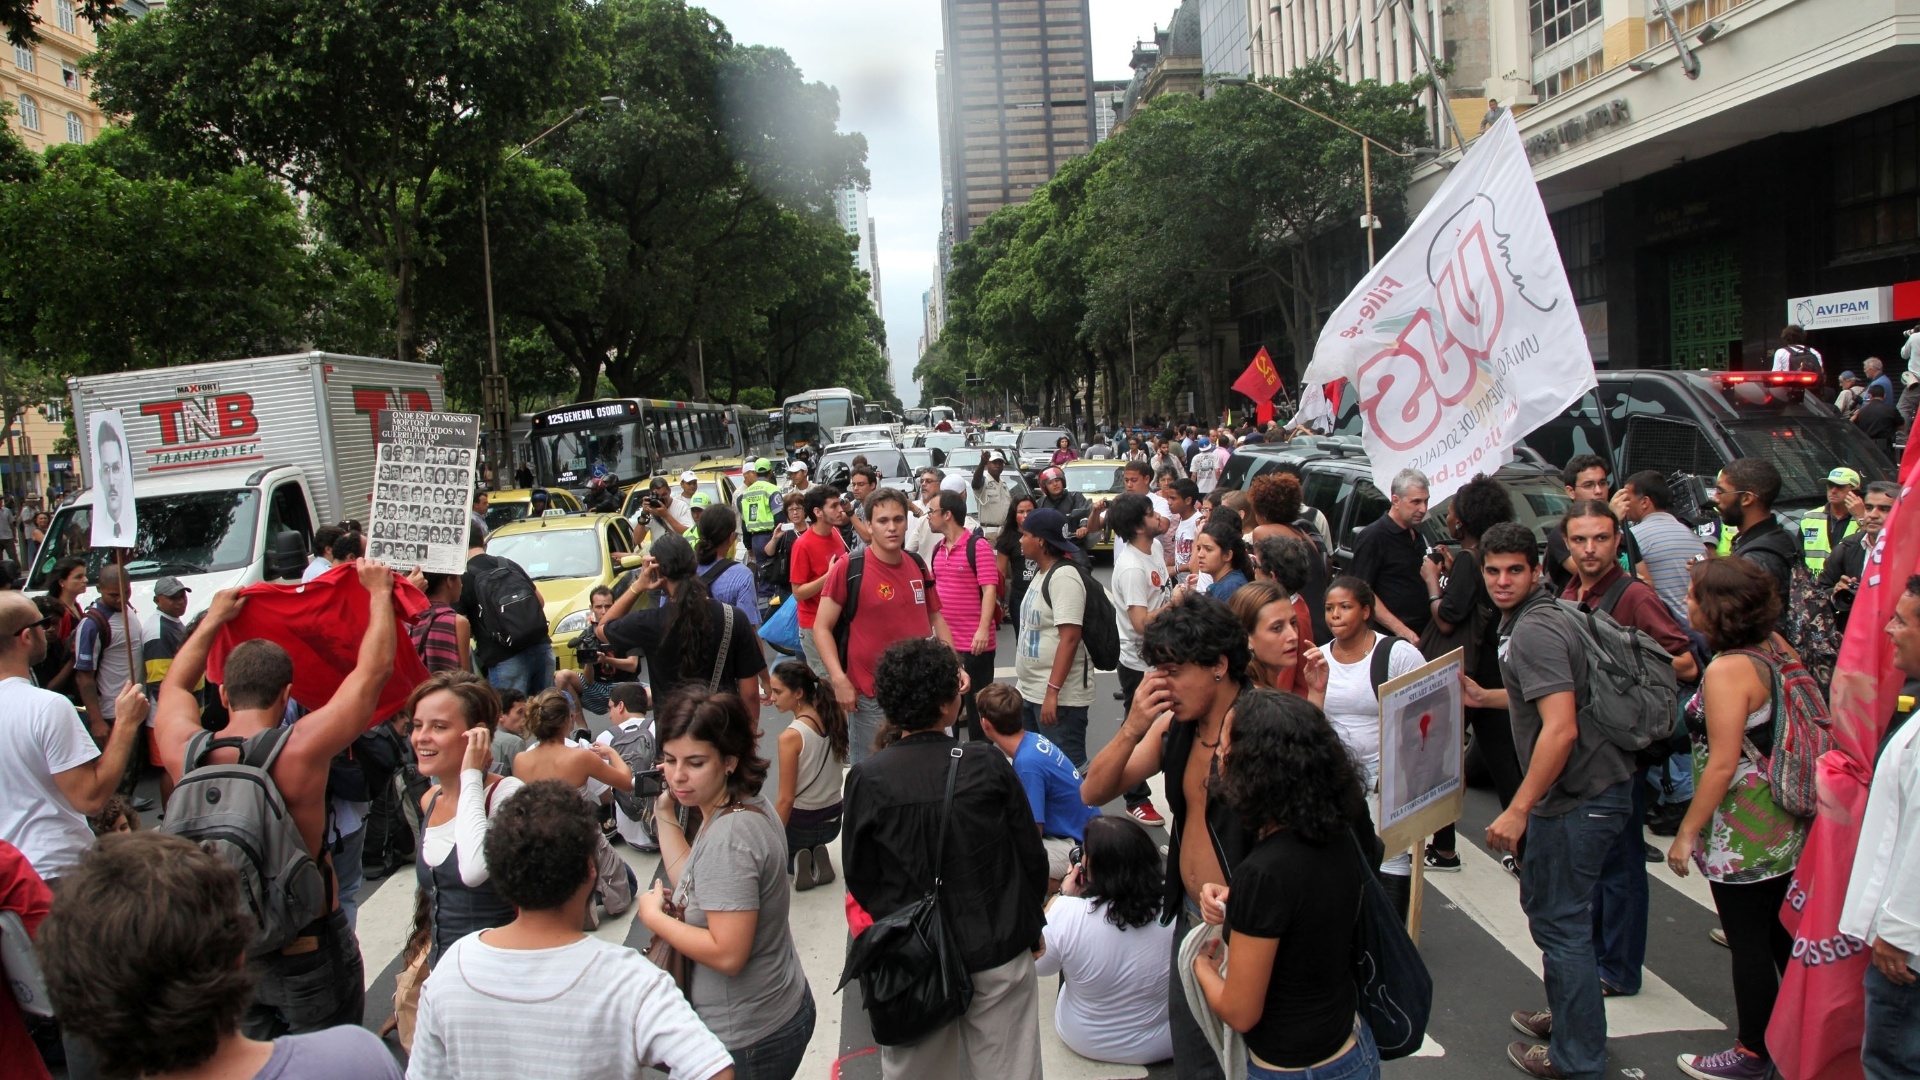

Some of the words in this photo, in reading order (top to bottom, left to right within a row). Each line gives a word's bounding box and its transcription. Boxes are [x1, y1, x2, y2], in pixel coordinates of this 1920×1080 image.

[1816, 300, 1869, 316] AVIPAM
[176, 383, 218, 394] MAXFORT
[139, 392, 259, 445] TNB
[392, 411, 415, 420] ONDE
[441, 415, 473, 423] NOSSOS
[547, 413, 564, 425] 125
[563, 408, 595, 423] GENERAL
[596, 404, 623, 418] OSORIO
[392, 418, 423, 427] MORTOS
[381, 430, 425, 440] GUERRILHA
[392, 424, 453, 435] DESAPARECIDOS
[454, 428, 466, 436] NA
[392, 438, 435, 447] ARAGUAIA?
[1408, 686, 1428, 702] STUART
[1429, 680, 1444, 692] ANGEL
[1390, 808, 1403, 820] PELA
[1404, 793, 1430, 812] COMISSÃO
[1437, 776, 1459, 793] VERDADE
